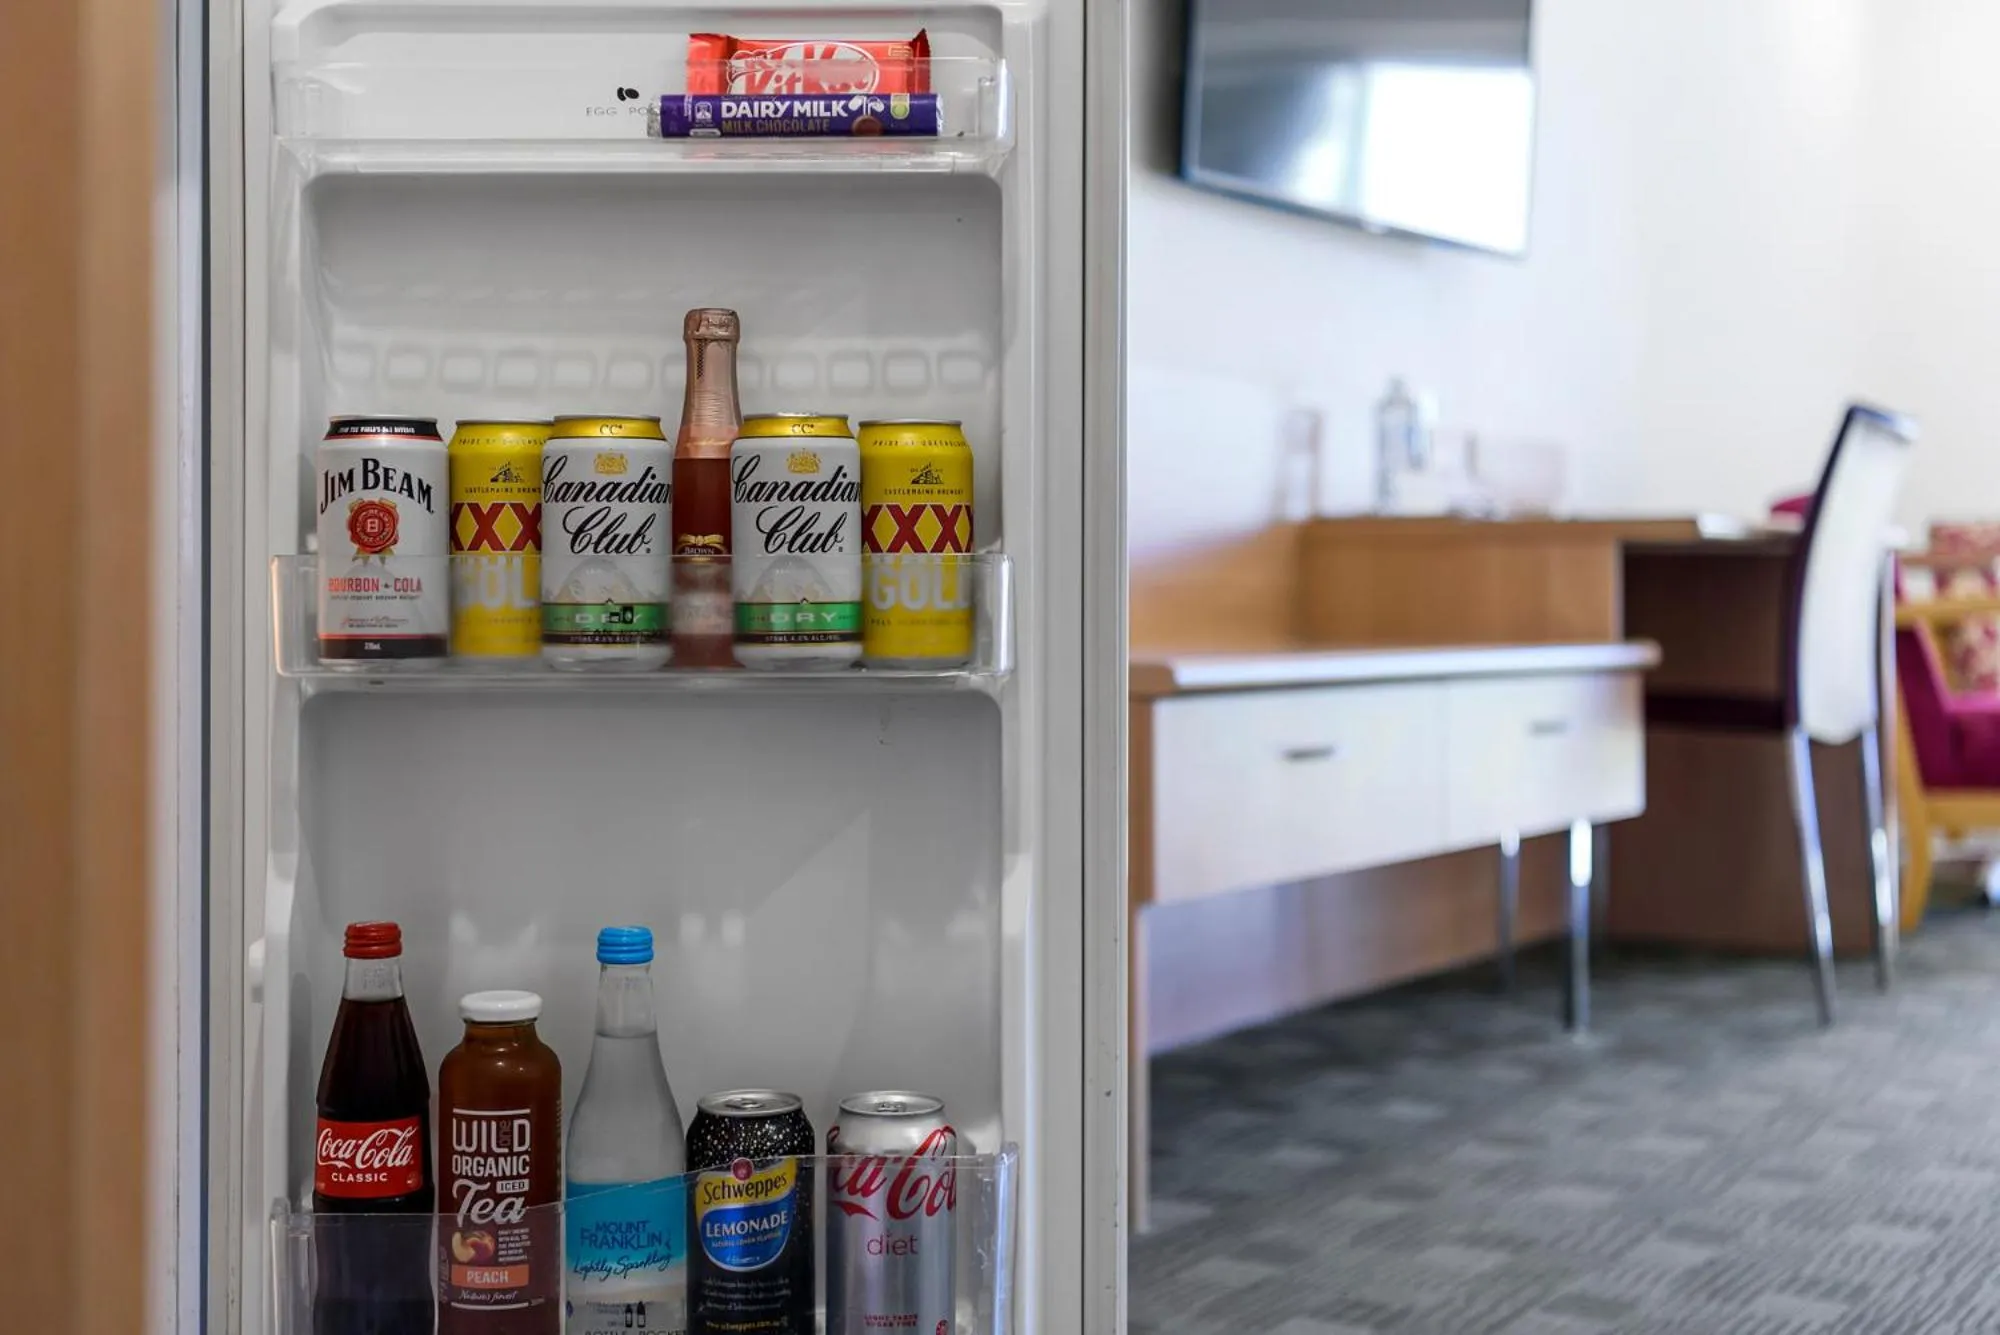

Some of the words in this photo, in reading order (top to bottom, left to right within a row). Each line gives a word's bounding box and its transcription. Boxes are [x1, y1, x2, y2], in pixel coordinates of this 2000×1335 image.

[585, 106, 618, 117] EGG
[721, 101, 790, 118] DAIRY
[793, 101, 849, 118] MILK
[722, 121, 754, 133] MILK
[756, 121, 831, 133] CHOCOLATE
[319, 468, 355, 516] JIM
[361, 457, 434, 515] BEAM
[543, 455, 672, 504] Canadian
[732, 454, 861, 503] Canadian
[684, 546, 716, 555] BROWN
[328, 577, 380, 593] BOURBON
[394, 577, 424, 593] COLA
[770, 612, 837, 624] DRY
[452, 1118, 531, 1153] WILD
[317, 1126, 419, 1170] Coca-Cola
[452, 1154, 531, 1177] ORGANIC
[331, 1172, 388, 1183] CLASSIC
[500, 1181, 526, 1192] ICED
[703, 1173, 788, 1205] Schweppes
[452, 1179, 527, 1228] Tea
[594, 1220, 651, 1235] MOUNT
[705, 1210, 789, 1238] LEMONADE
[580, 1227, 663, 1251] FRANKLIN
[867, 1231, 919, 1256] diet
[466, 1270, 510, 1285] PEACH
[573, 1256, 613, 1282] Lightly
